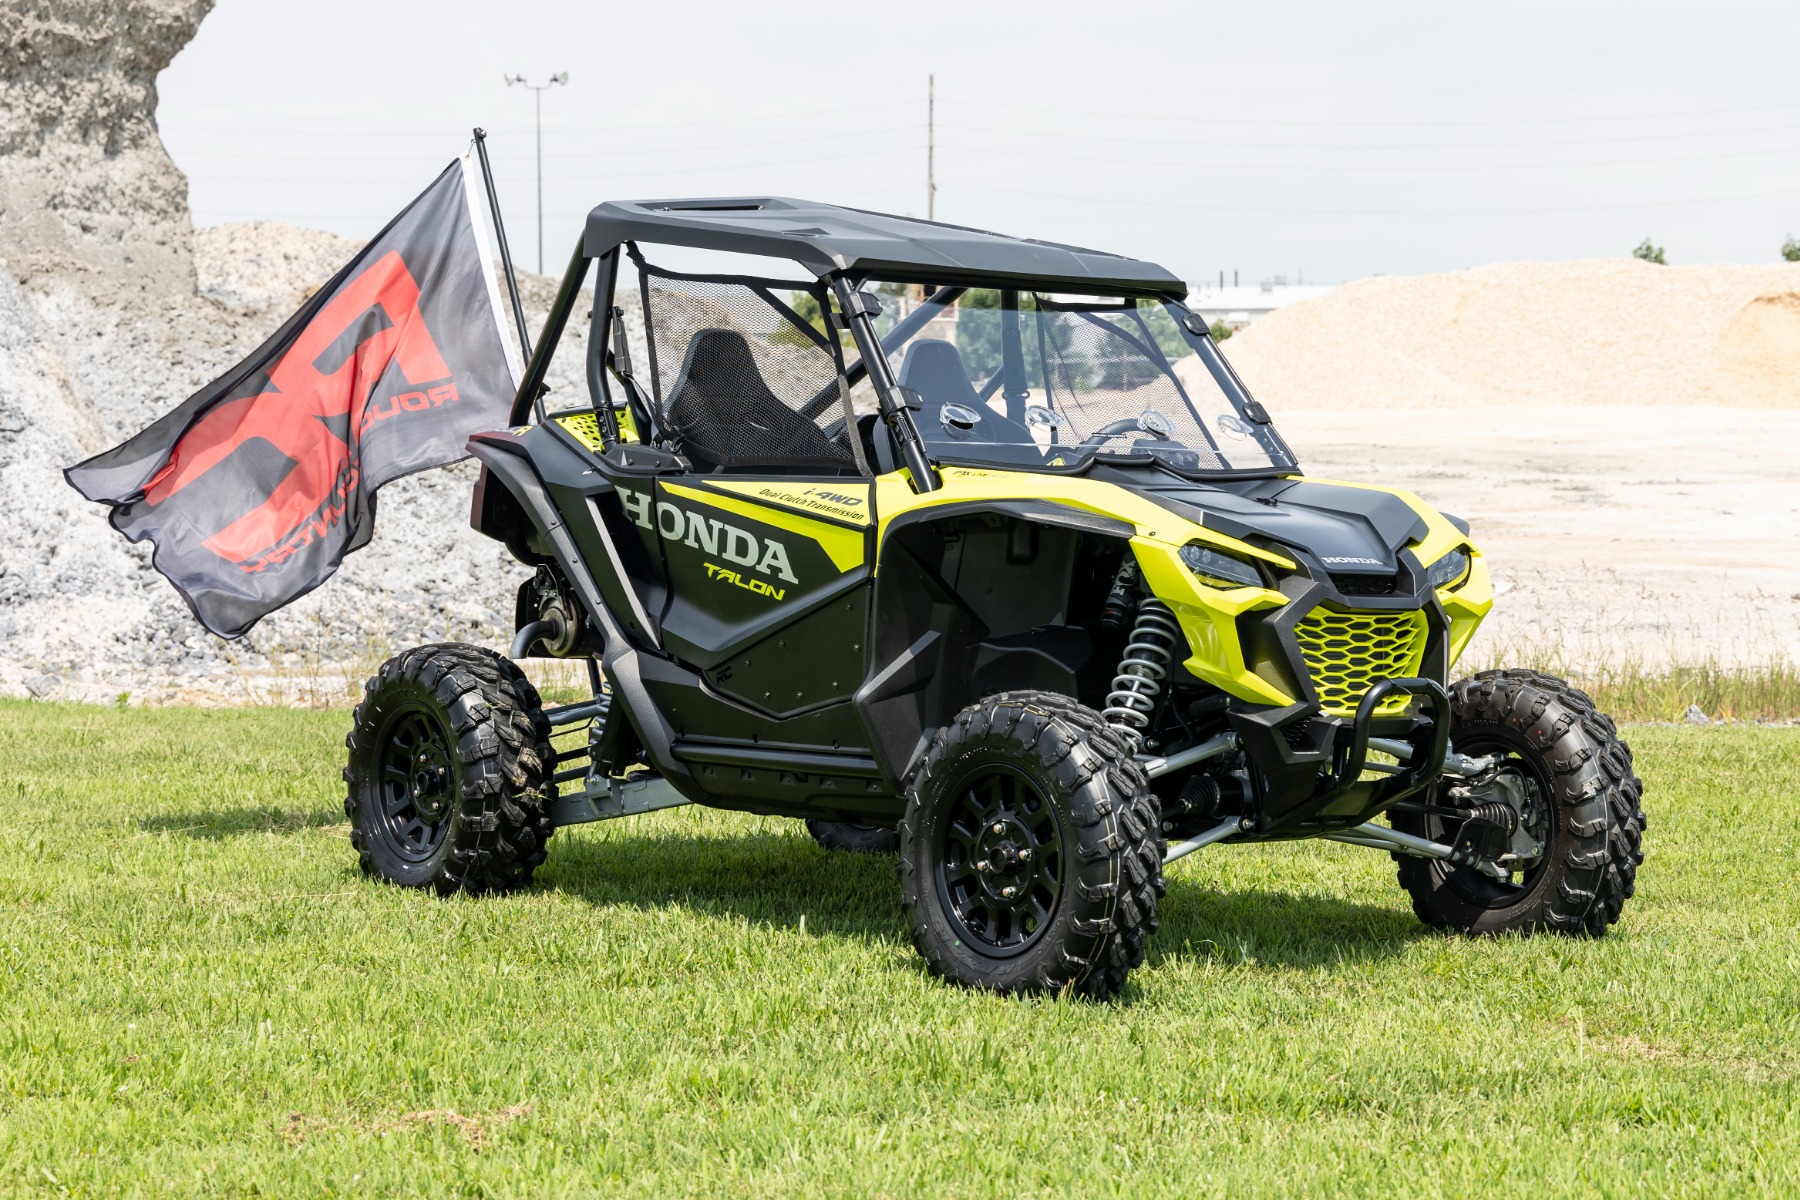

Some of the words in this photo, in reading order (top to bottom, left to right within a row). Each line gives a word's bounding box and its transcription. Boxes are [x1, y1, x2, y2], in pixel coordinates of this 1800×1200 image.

[759, 488, 781, 498] Dual
[779, 493, 807, 506] Clutch
[807, 500, 865, 521] Transmission
[614, 485, 799, 585] HONDA
[1109, 559, 1137, 596] FOX
[1321, 556, 1384, 565] HONDA
[703, 562, 786, 601] TALON
